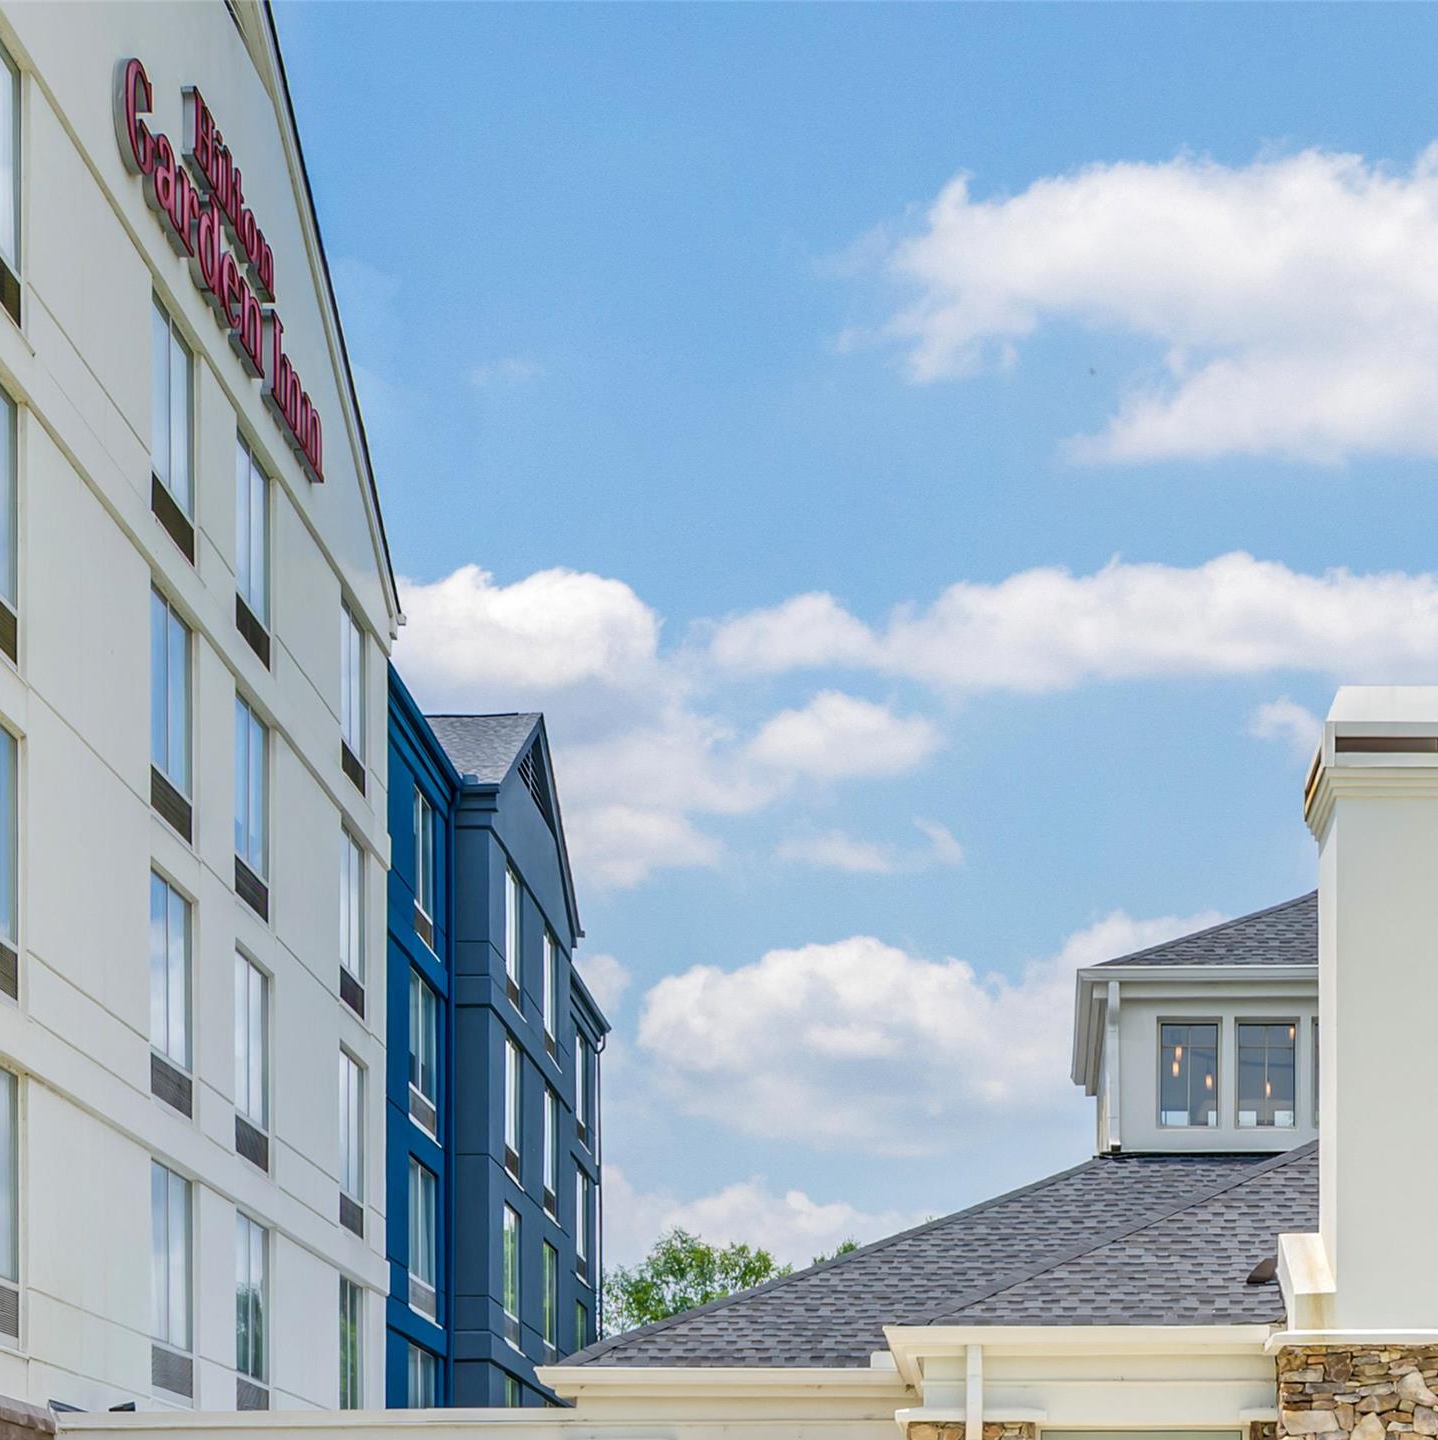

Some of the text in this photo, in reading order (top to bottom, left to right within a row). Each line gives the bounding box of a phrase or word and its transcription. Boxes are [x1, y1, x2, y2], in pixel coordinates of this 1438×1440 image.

[114, 57, 324, 484] Garden Inn
[182, 85, 275, 303] Hilton
